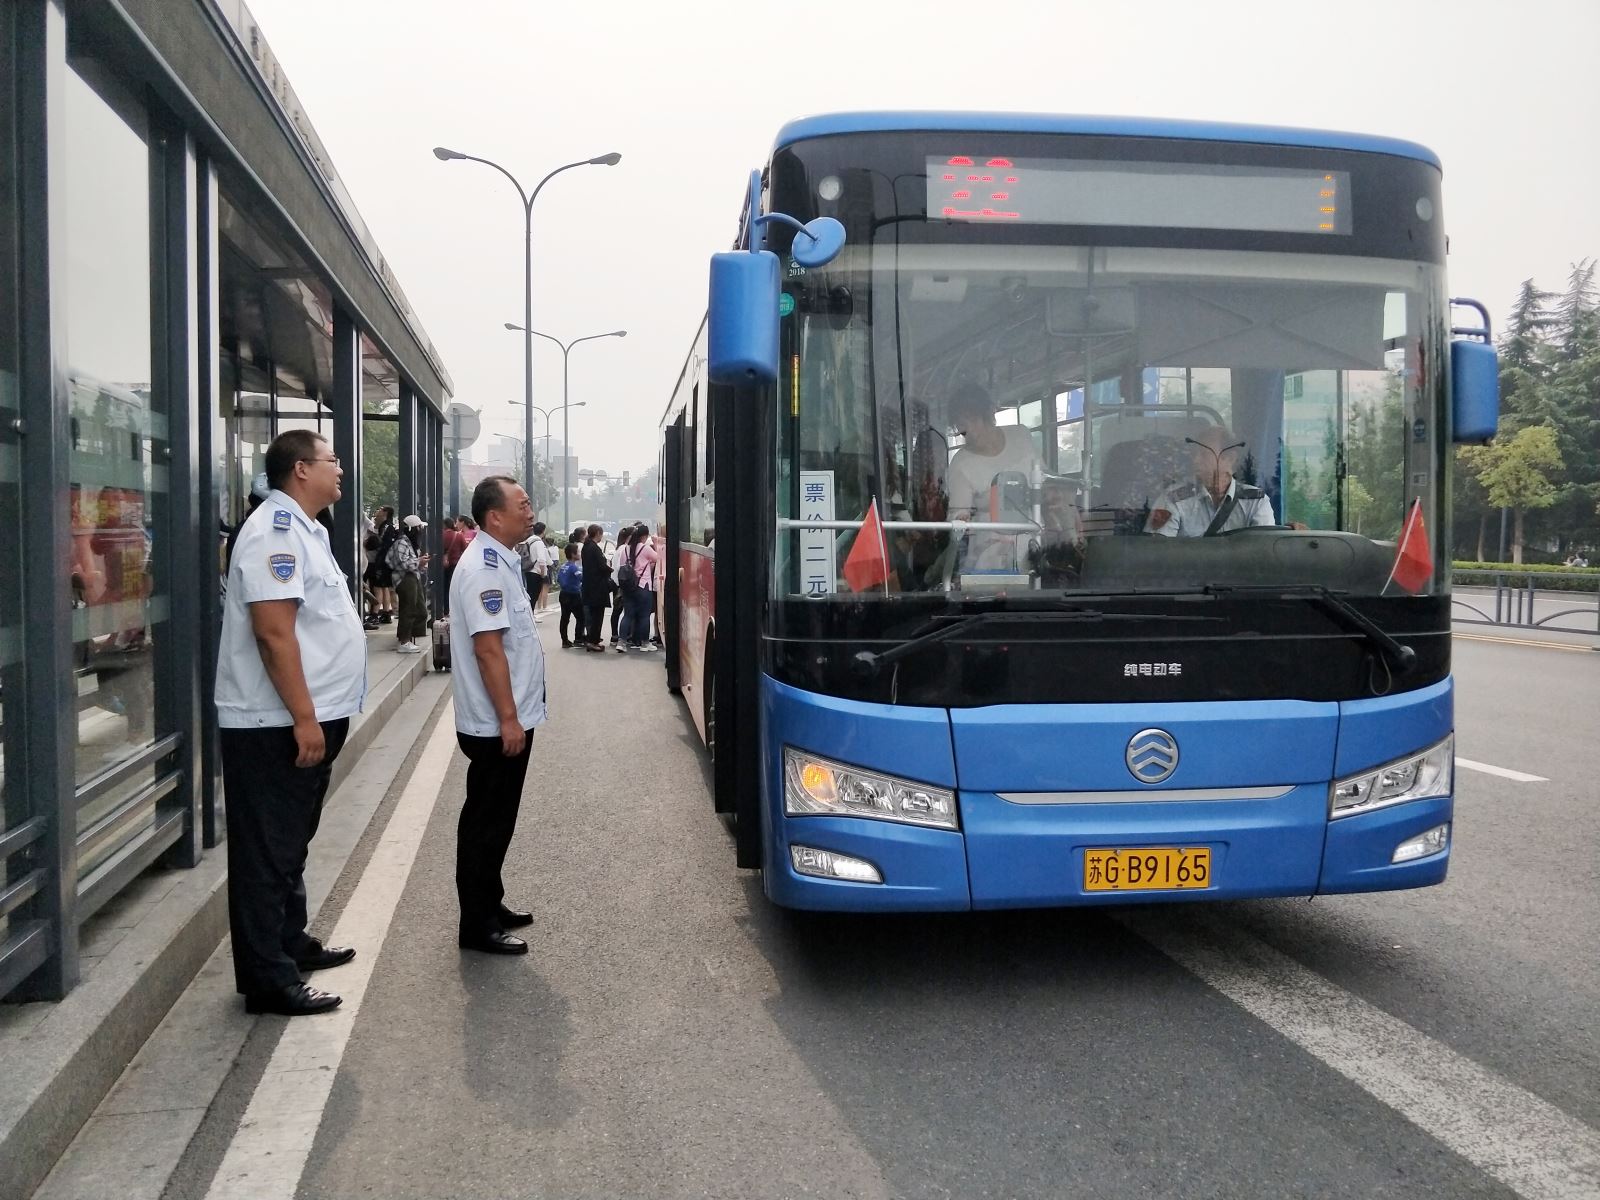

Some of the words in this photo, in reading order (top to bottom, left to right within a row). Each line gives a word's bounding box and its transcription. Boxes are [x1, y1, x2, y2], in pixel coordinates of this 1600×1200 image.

[788, 267, 806, 277] 2018
[1124, 663, 1182, 676] 纯电动车
